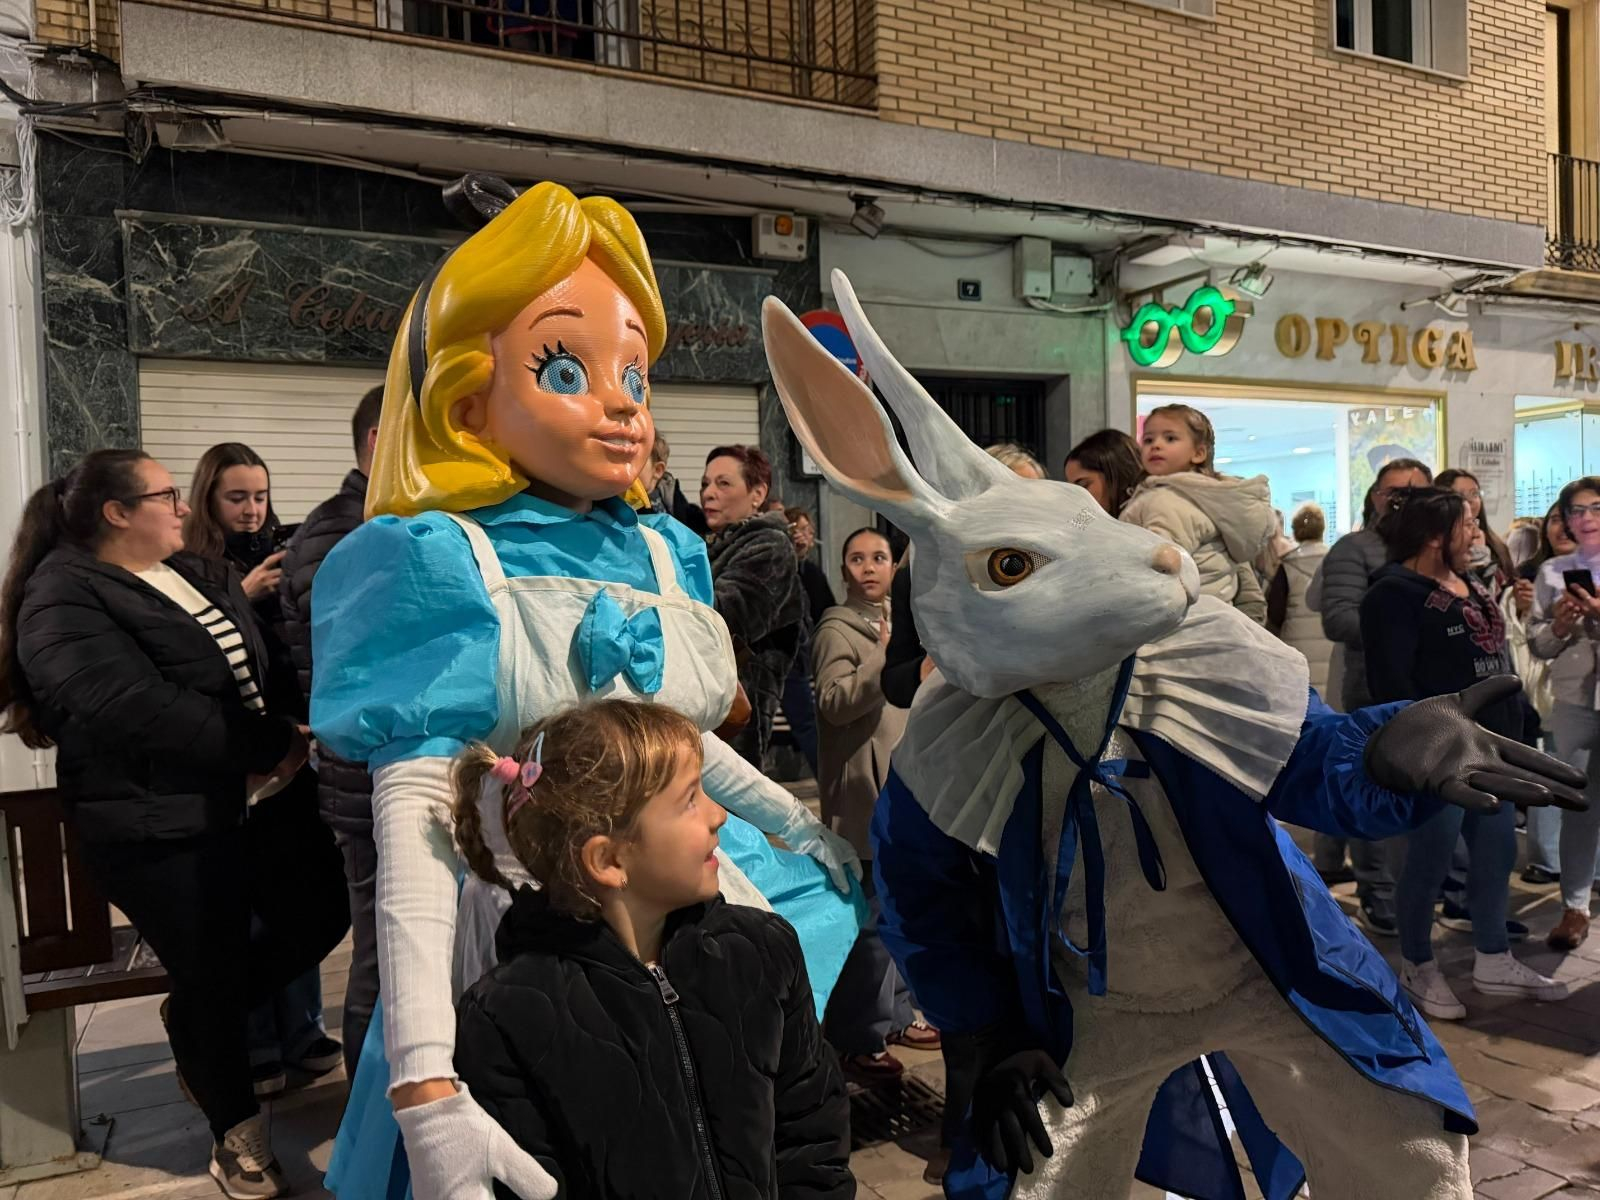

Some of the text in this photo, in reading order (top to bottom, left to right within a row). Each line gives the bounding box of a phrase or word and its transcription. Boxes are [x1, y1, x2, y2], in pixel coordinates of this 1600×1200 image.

[966, 285, 976, 295] 7
[1274, 312, 1478, 372] OPTICA
[1446, 624, 1465, 636] NYC
